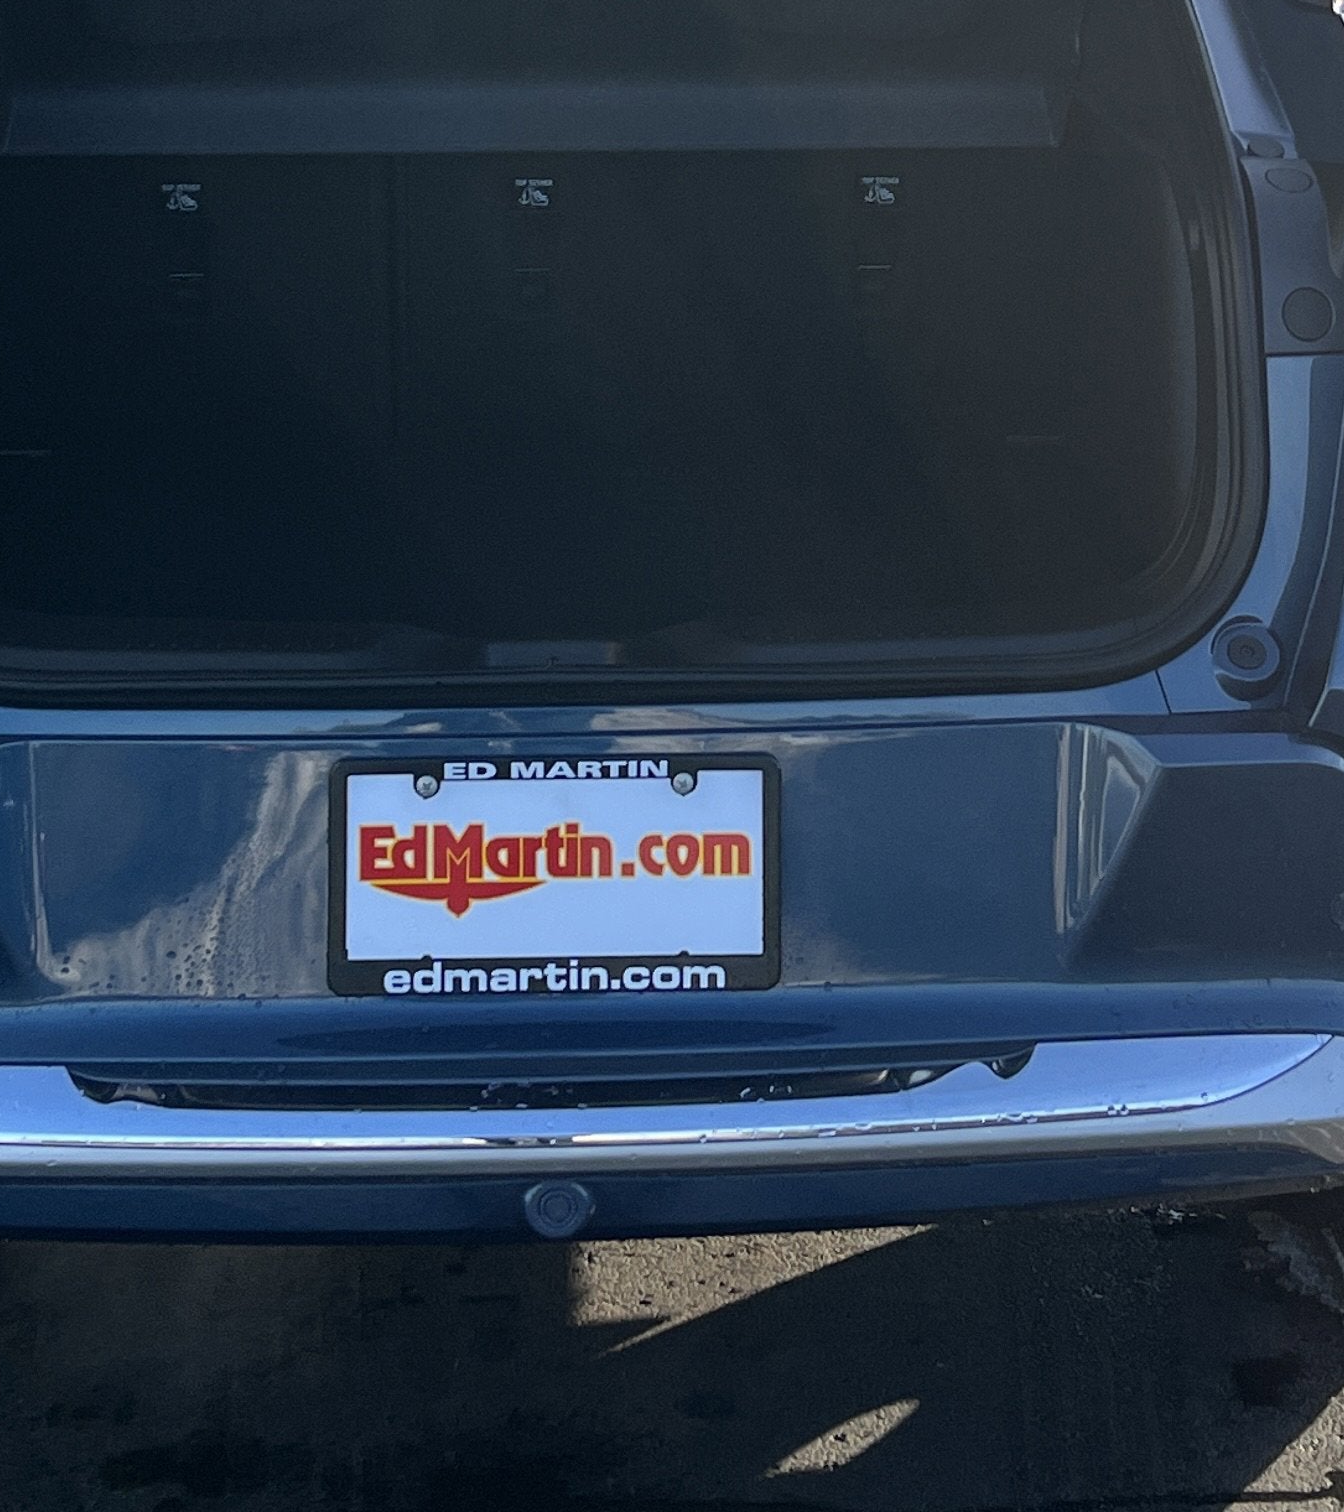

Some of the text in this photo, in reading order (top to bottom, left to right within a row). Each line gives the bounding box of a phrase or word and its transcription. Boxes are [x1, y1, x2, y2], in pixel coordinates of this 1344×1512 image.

[443, 759, 669, 780] ED MARTIN
[358, 821, 752, 882] EdMartin.com
[383, 959, 726, 995] edmartin.com
